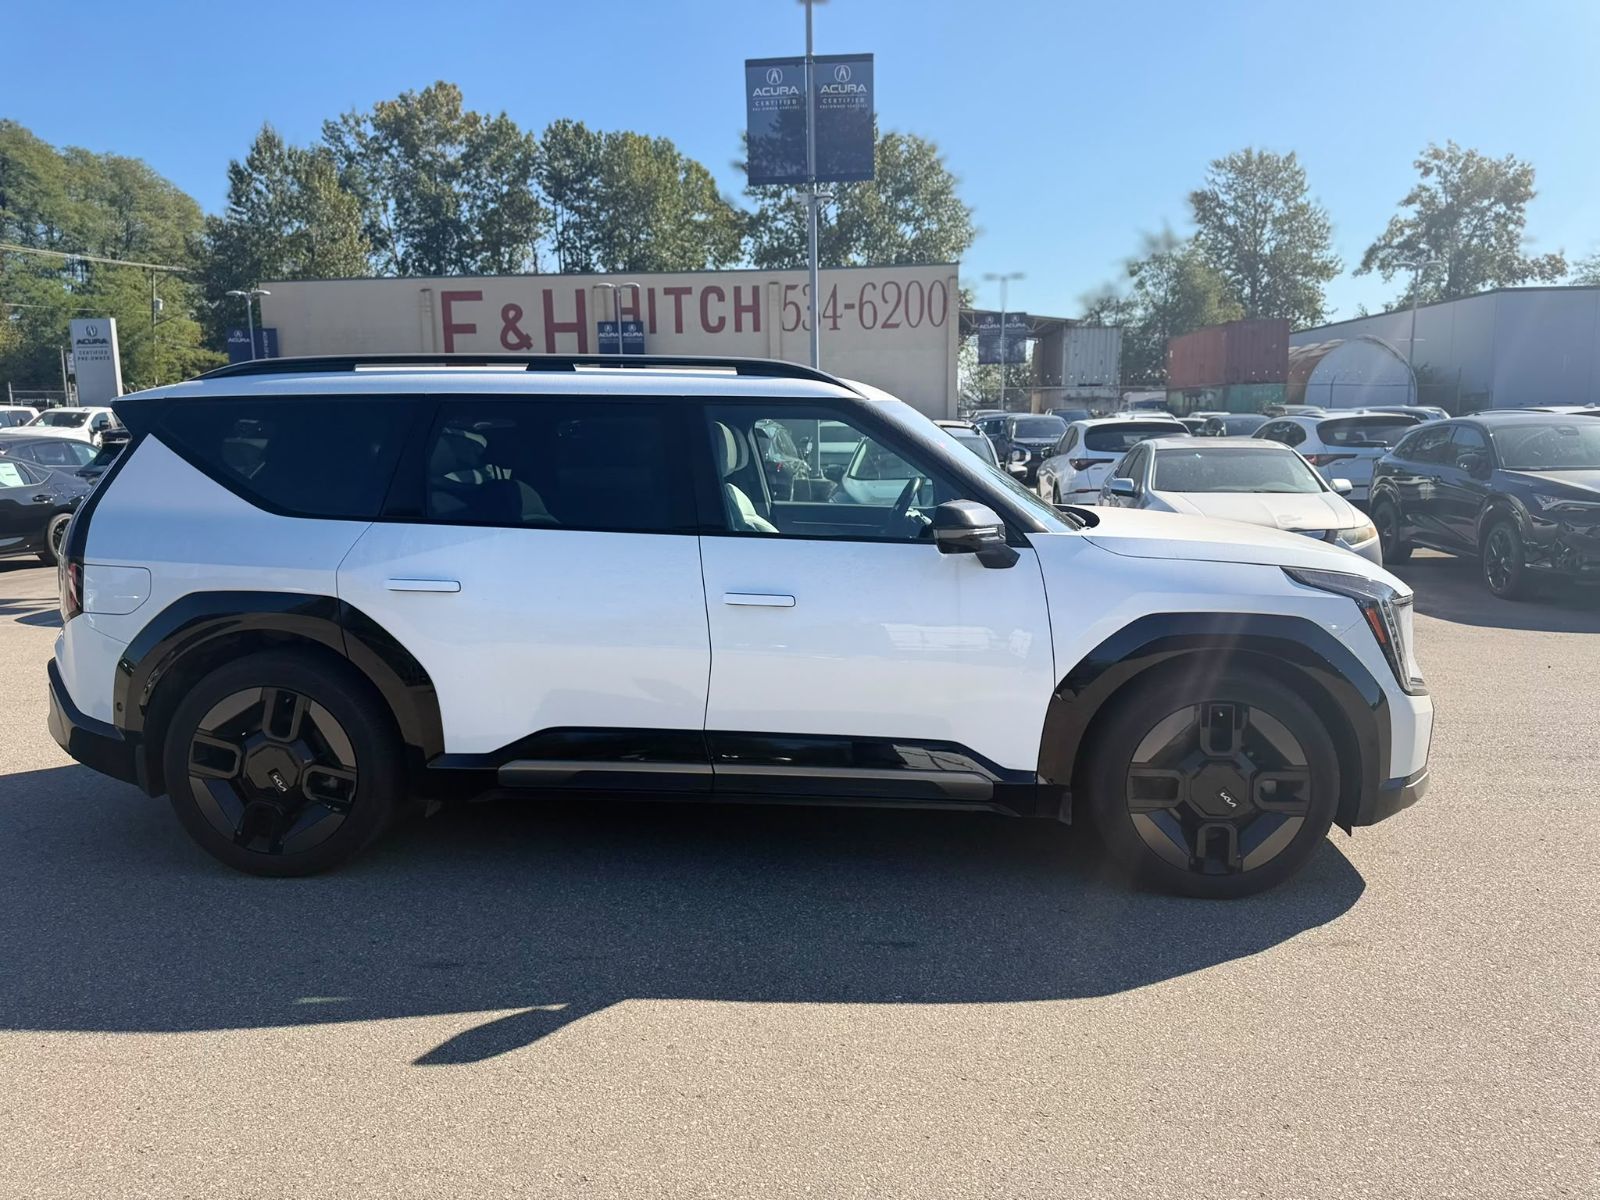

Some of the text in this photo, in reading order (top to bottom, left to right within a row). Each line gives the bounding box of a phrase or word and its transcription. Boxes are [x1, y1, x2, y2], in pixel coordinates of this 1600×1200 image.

[753, 86, 799, 96] ACURA
[820, 84, 867, 93] ACURA
[500, 303, 533, 350] &
[543, 288, 588, 364] H
[614, 285, 760, 334] HITCH
[273, 774, 287, 792] KIA
[1220, 792, 1237, 808] KIA
